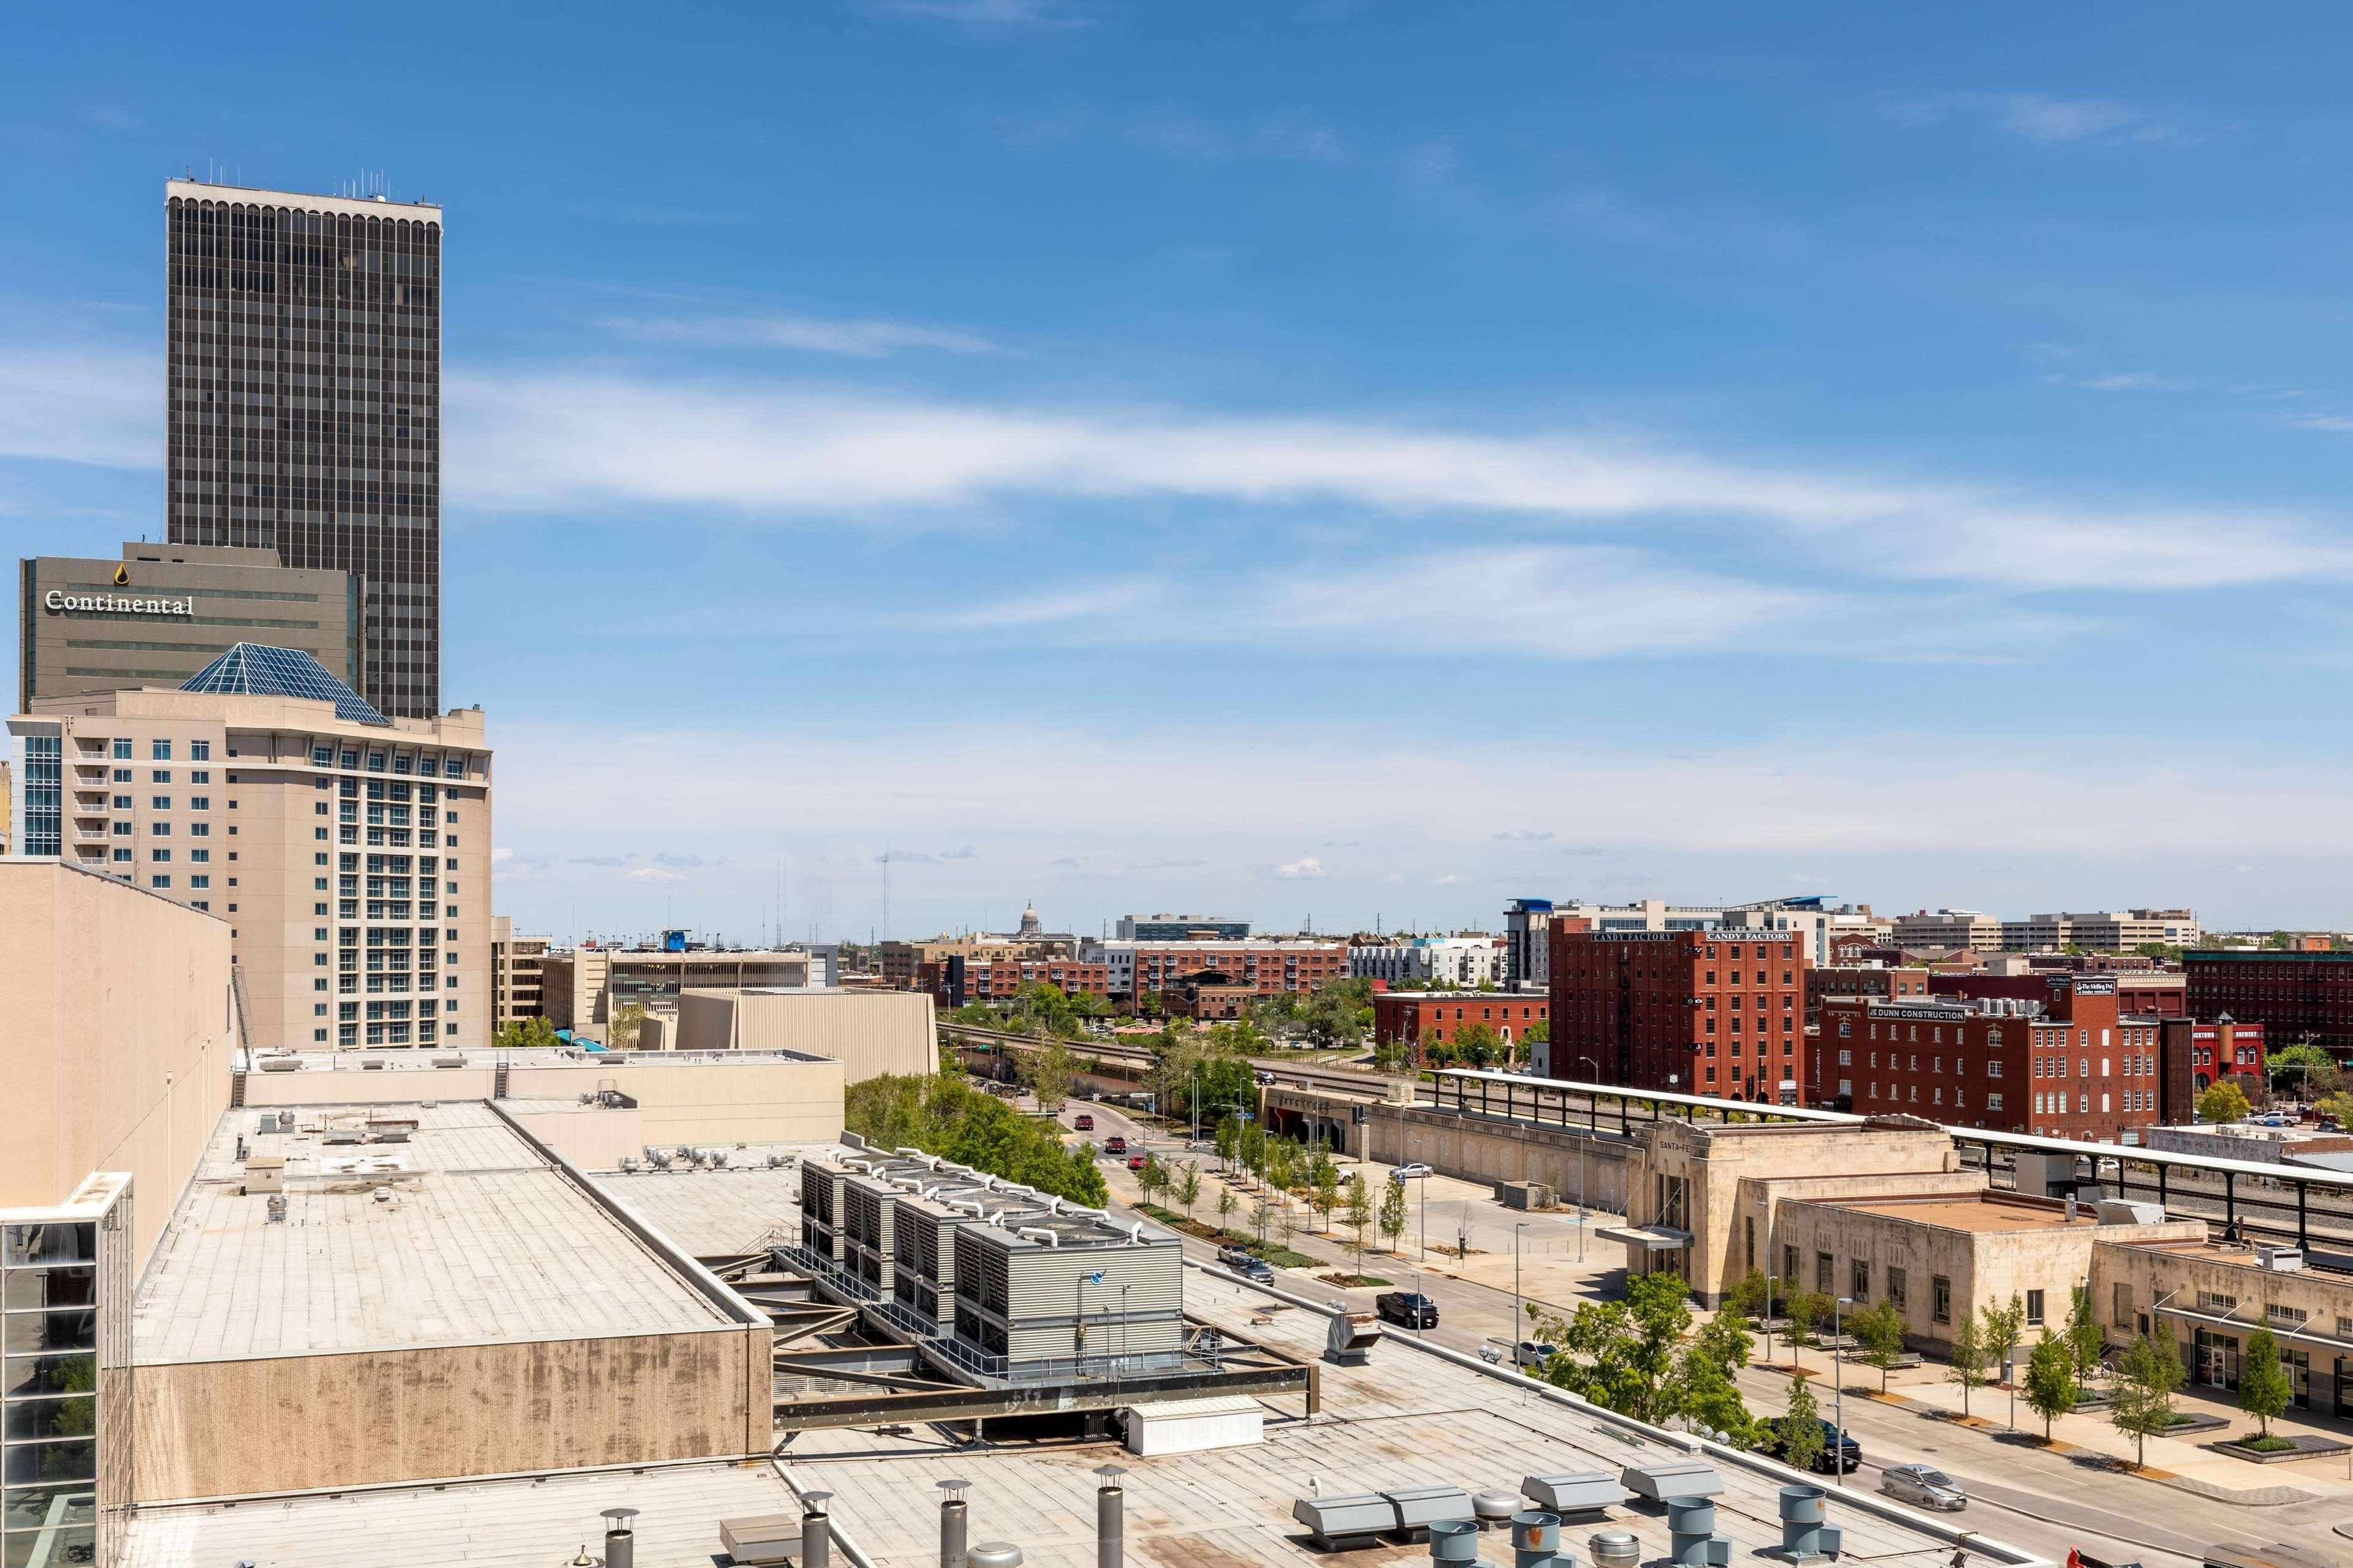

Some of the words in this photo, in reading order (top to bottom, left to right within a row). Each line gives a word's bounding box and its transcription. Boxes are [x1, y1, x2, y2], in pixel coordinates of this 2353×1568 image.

[45, 590, 194, 615] Continental
[1901, 1010, 1963, 1020] CONSTRUCTION
[1660, 1141, 1690, 1153] SANTA-FE
